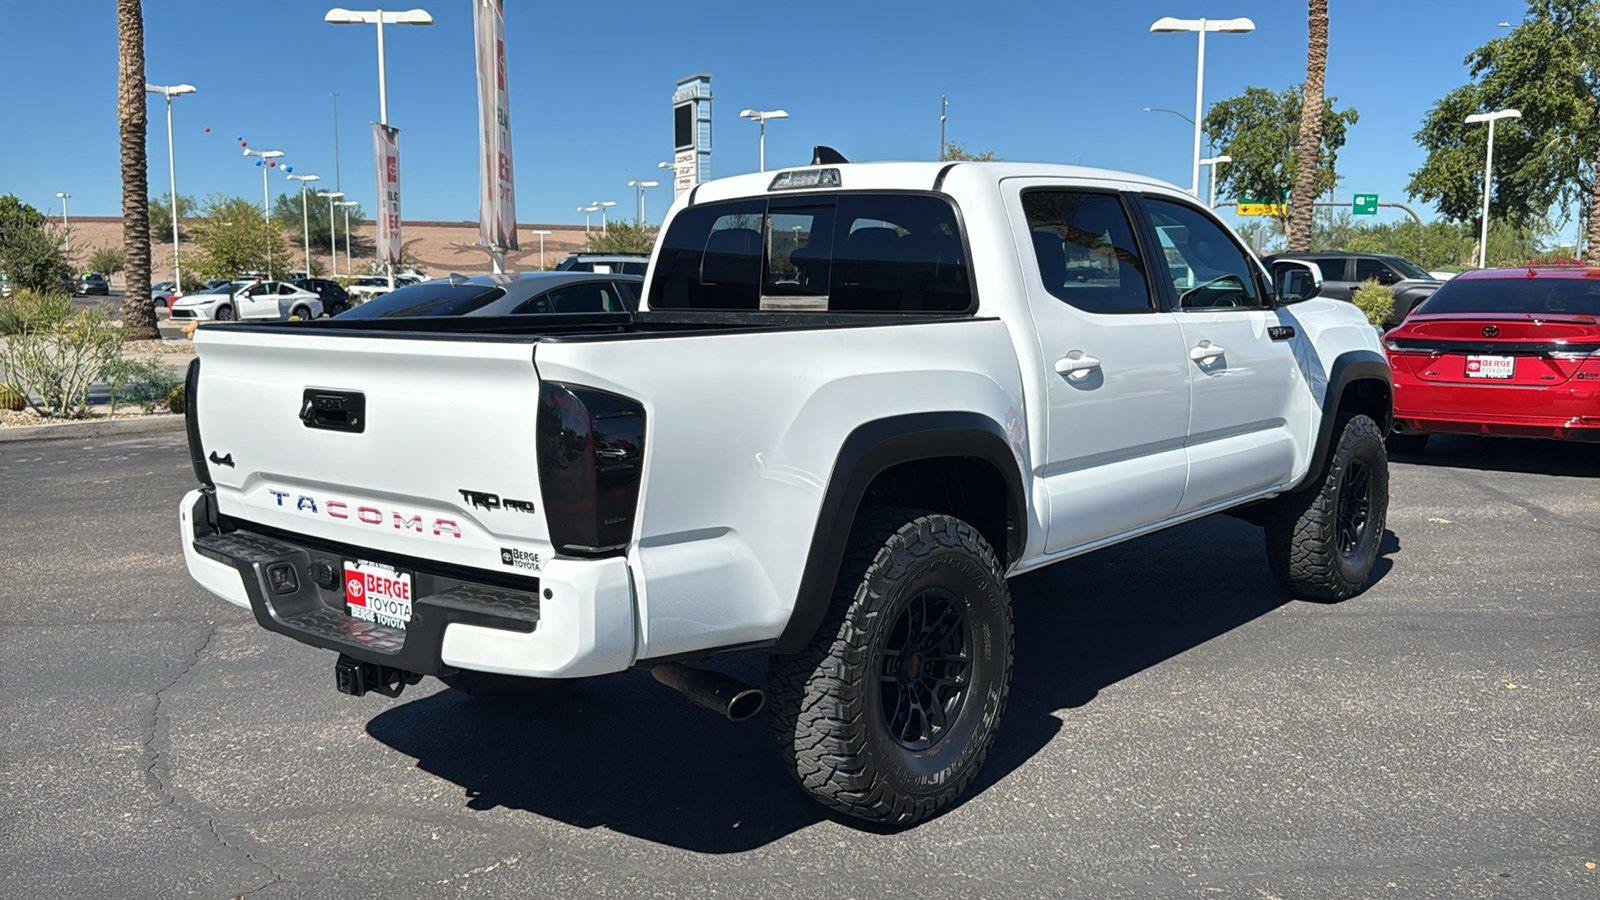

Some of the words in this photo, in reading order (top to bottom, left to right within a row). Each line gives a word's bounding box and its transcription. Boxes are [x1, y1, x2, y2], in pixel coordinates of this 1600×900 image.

[1482, 360, 1512, 368] BERGE
[458, 488, 501, 511] TRD
[502, 498, 535, 514] PRO
[269, 488, 462, 538] TACOMA
[512, 548, 540, 563] BERGE
[514, 560, 542, 572] TOYOTA
[366, 573, 409, 600] BERGE
[367, 596, 412, 617] TOYOTA
[351, 606, 376, 623] BERGE
[377, 612, 407, 631] TOYOTA
